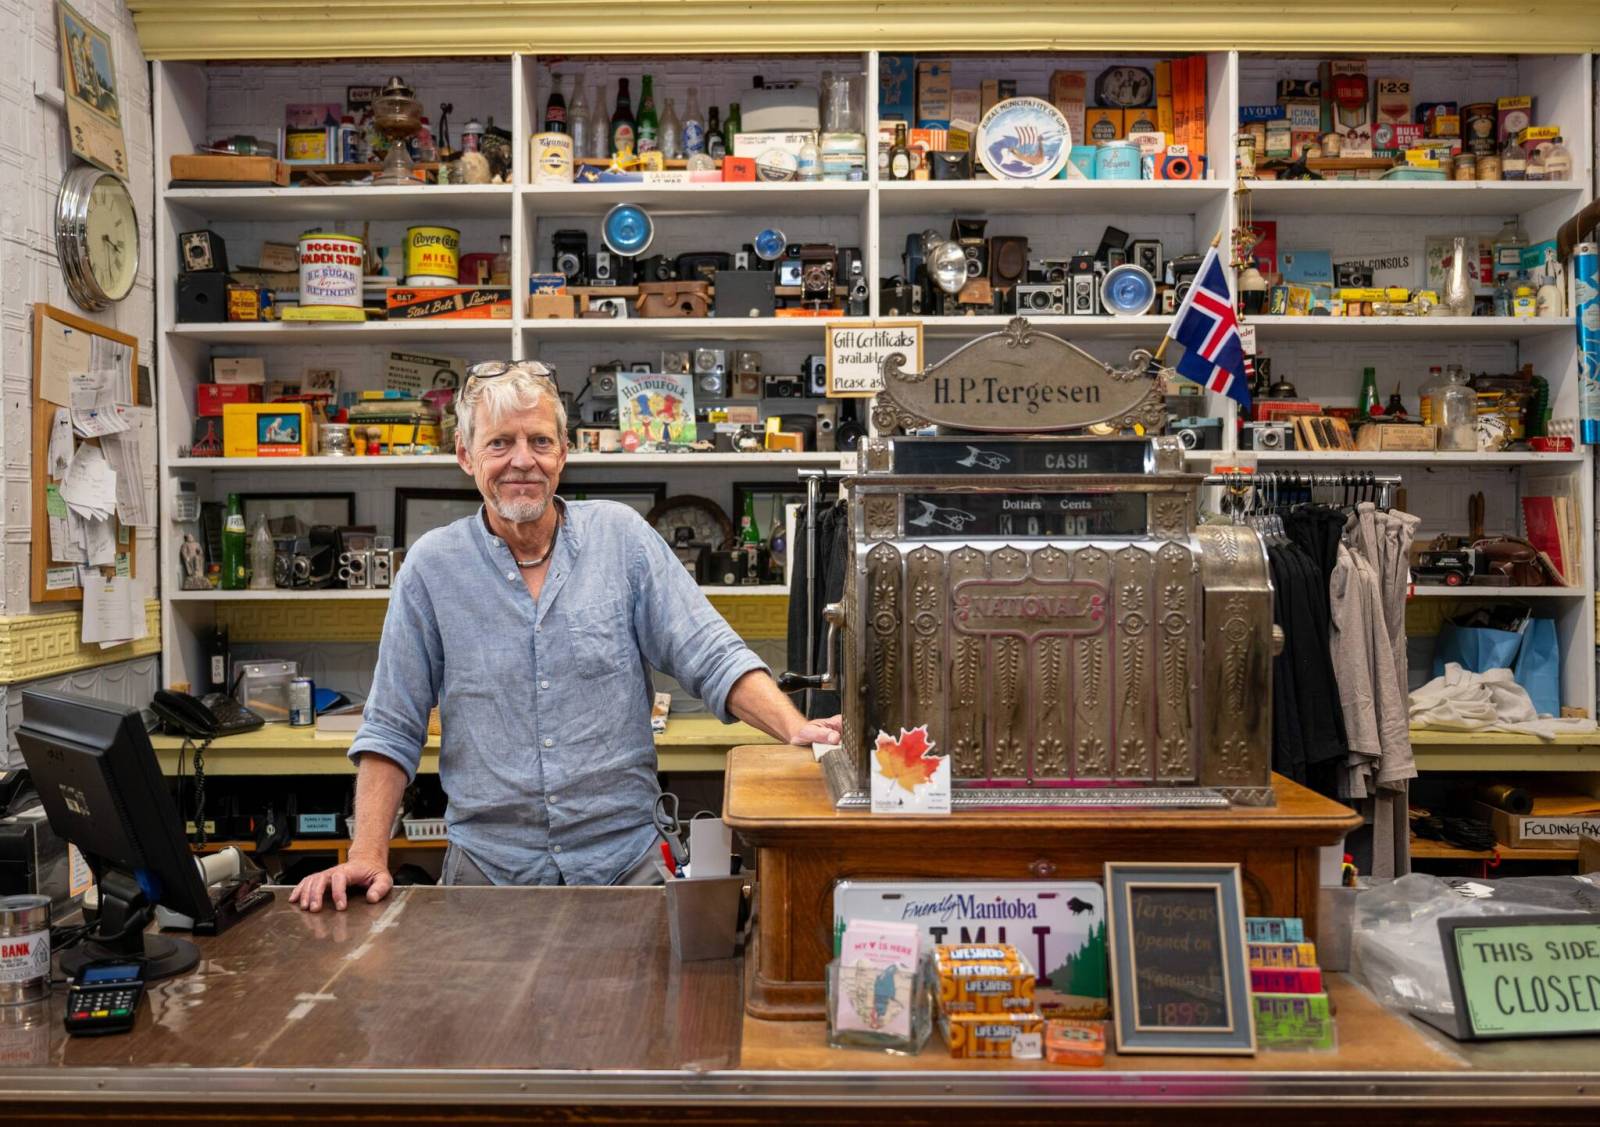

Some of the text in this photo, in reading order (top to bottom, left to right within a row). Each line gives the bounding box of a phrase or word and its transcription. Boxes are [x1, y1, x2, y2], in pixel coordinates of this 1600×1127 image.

[1243, 106, 1279, 115] IVORY
[1397, 127, 1421, 135] BULL
[301, 254, 335, 265] GOLDEN
[336, 254, 362, 266] SYRUP
[423, 253, 453, 263] MIEL
[322, 268, 356, 281] SUGAR
[306, 286, 357, 297] REFINERY
[467, 291, 499, 307] Lacing
[834, 330, 914, 348] Gift Certificates
[834, 377, 865, 389] Please
[1045, 454, 1088, 469] CASH
[1002, 499, 1093, 510] Dollars Cents
[972, 595, 1086, 618] NATIONAL
[1524, 821, 1579, 837] FOLDING
[901, 893, 1038, 922] Friendly Manitoba
[1, 943, 30, 959] BANK
[890, 944, 912, 955] HERE
[1472, 940, 1600, 963] THIS SIDE
[1494, 975, 1600, 1015] CLOSED
[1156, 1002, 1210, 1027] 1899
